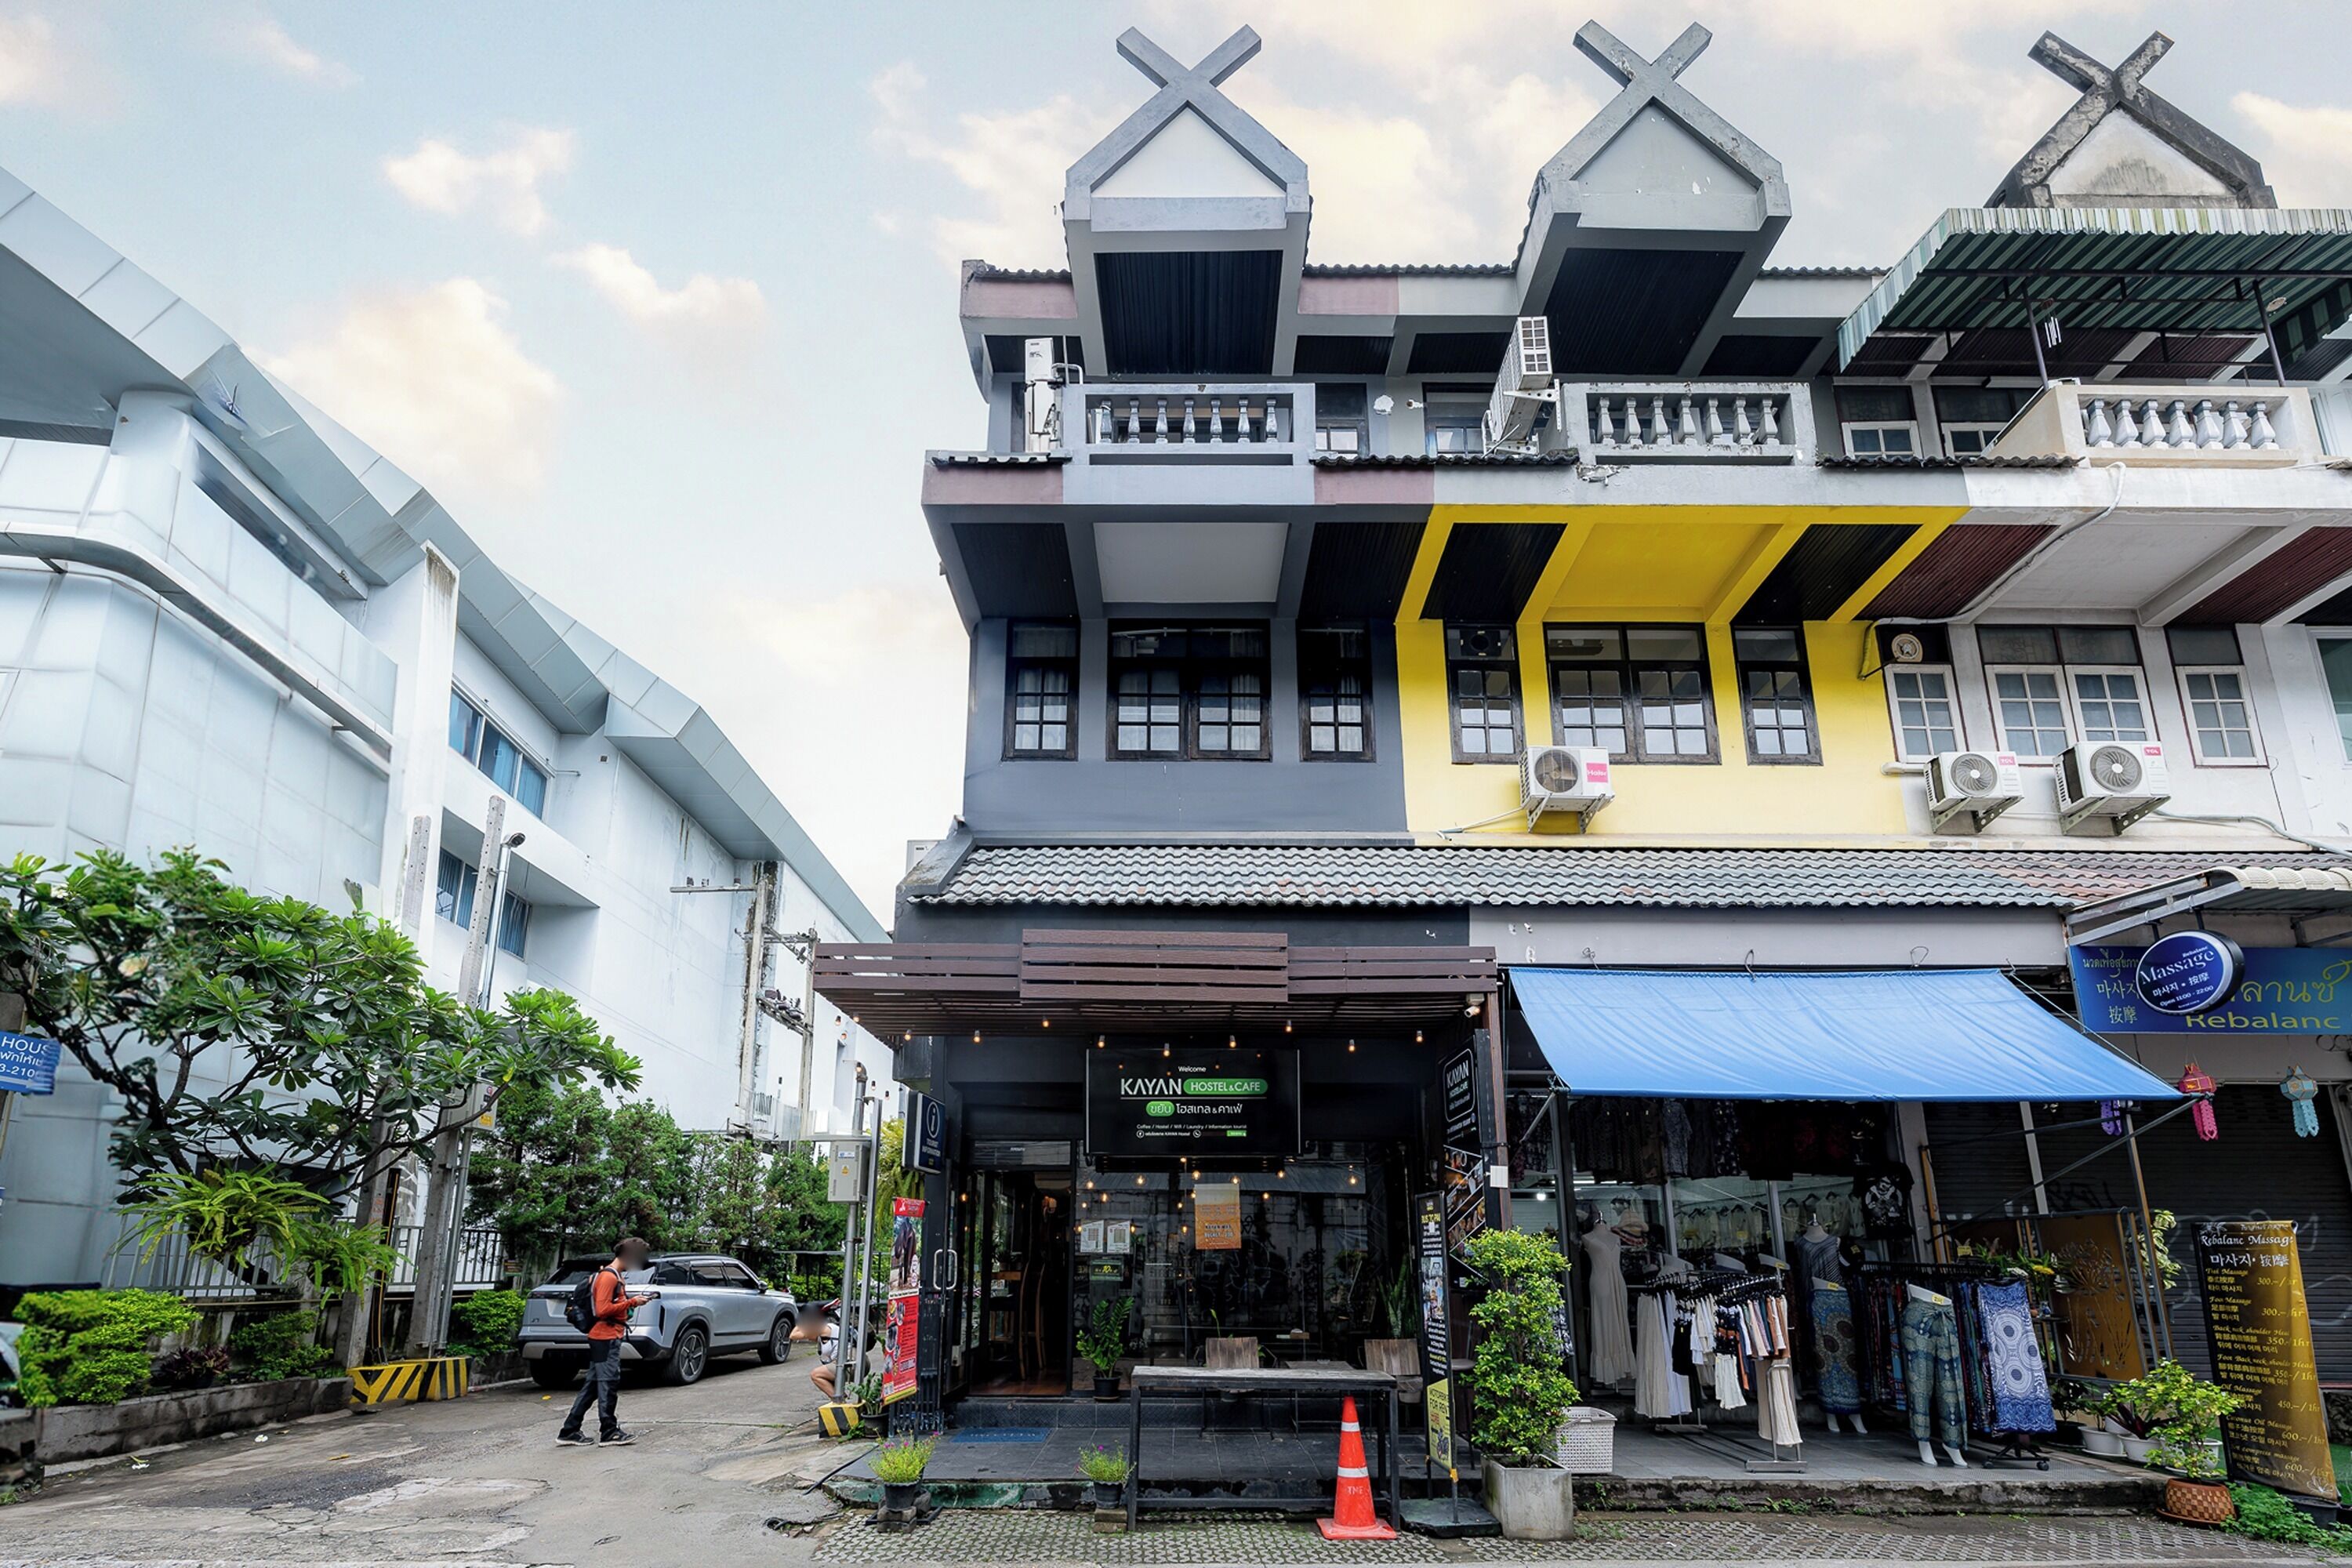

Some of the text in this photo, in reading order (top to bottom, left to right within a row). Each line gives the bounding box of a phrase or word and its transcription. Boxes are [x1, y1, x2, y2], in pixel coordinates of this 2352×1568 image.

[2140, 951, 2215, 985] Massage
[2153, 982, 2180, 997] 마사지
[2196, 985, 2214, 995] 22:00
[2185, 1011, 2342, 1029] Rebalanc
[1446, 1060, 1469, 1089] KAYAN
[1120, 1078, 1181, 1095] KAYAN
[1150, 1103, 1171, 1114] ขยัน
[2201, 1234, 2245, 1247] Rebalanc
[2209, 1253, 2252, 1267] 마사지
